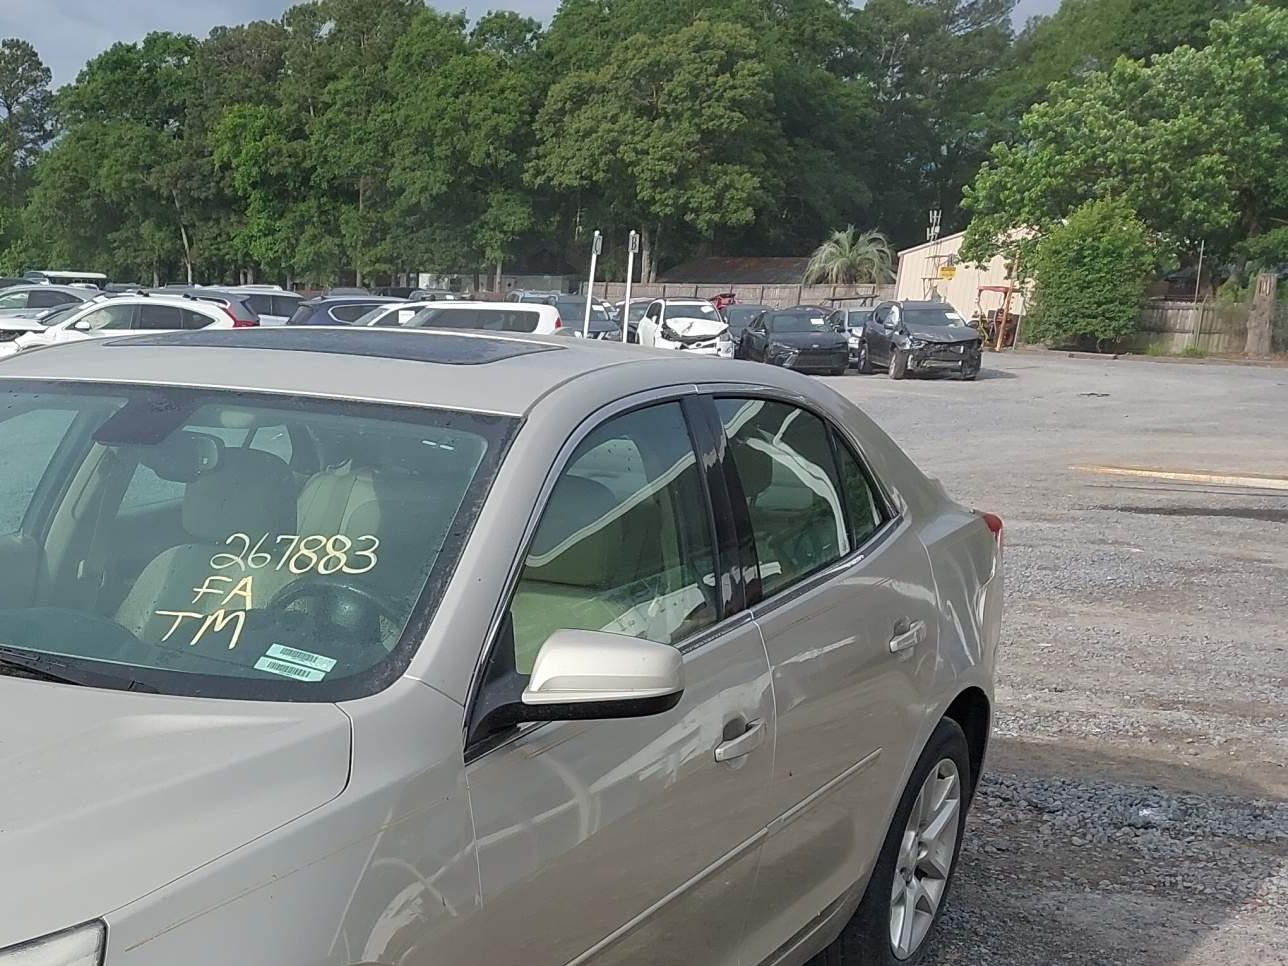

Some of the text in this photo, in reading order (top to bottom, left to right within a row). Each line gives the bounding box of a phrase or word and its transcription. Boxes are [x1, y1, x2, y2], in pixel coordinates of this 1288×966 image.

[210, 532, 380, 575] 267883
[192, 575, 254, 611] FA
[155, 608, 246, 650] TM
